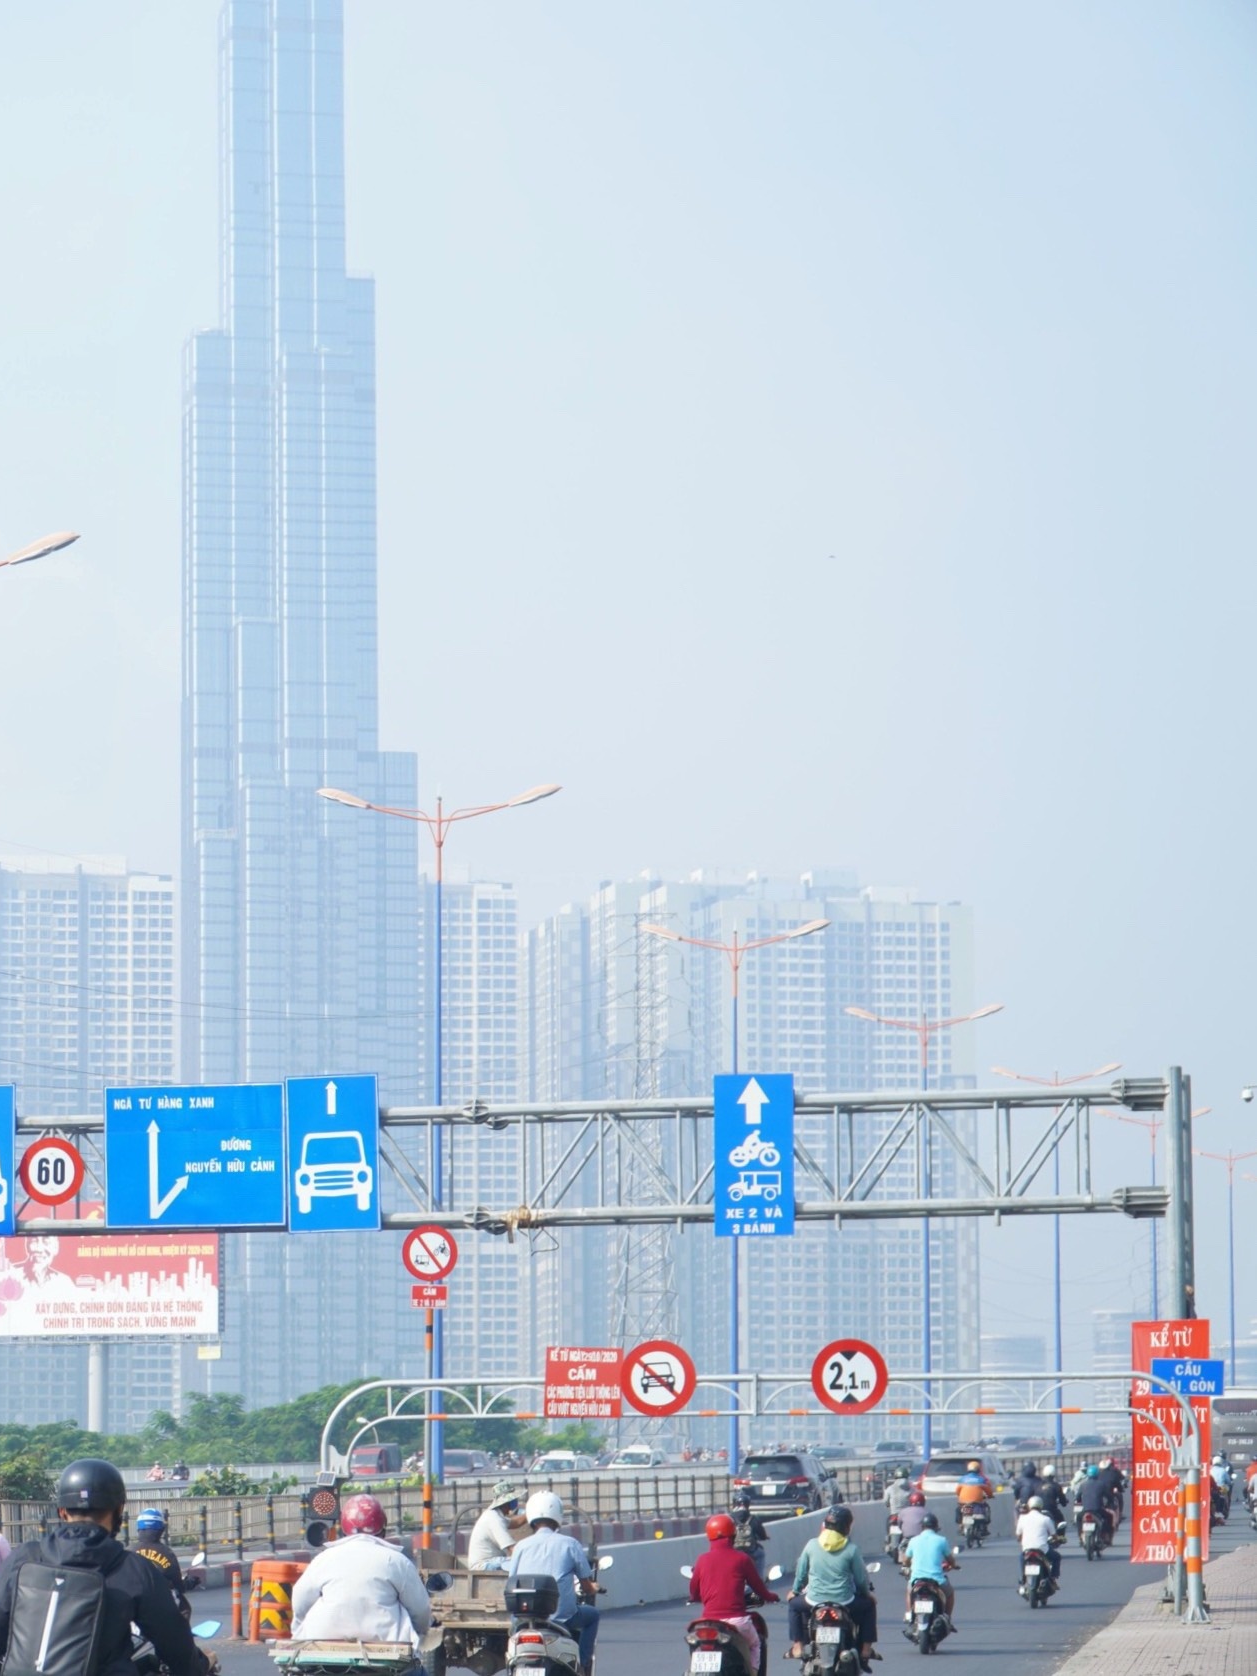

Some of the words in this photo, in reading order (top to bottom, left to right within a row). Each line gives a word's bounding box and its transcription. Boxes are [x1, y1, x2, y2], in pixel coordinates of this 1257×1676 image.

[114, 1096, 132, 1110] NGÃ
[139, 1097, 153, 1110] TƯ
[158, 1095, 183, 1109] HÀNG
[189, 1096, 214, 1109] XANH
[37, 1158, 66, 1185] 60
[227, 1157, 245, 1172] HỮU
[251, 1156, 275, 1172] CẢNH
[726, 1208, 745, 1219] XE
[749, 1208, 758, 1218] 2
[765, 1204, 783, 1218] VÀ
[732, 1224, 740, 1234] 3
[744, 1221, 775, 1234] BÁNH
[36, 1301, 51, 1314] XÂY
[88, 1316, 115, 1328] TRONG
[1150, 1323, 1169, 1347] KỂ
[1173, 1326, 1192, 1347] TỪ
[568, 1364, 597, 1380] CẤM
[1189, 1377, 1215, 1392] GÒN
[1135, 1459, 1165, 1478] HỮU
[1136, 1490, 1161, 1506] THI
[1140, 1511, 1173, 1533] CẤM
